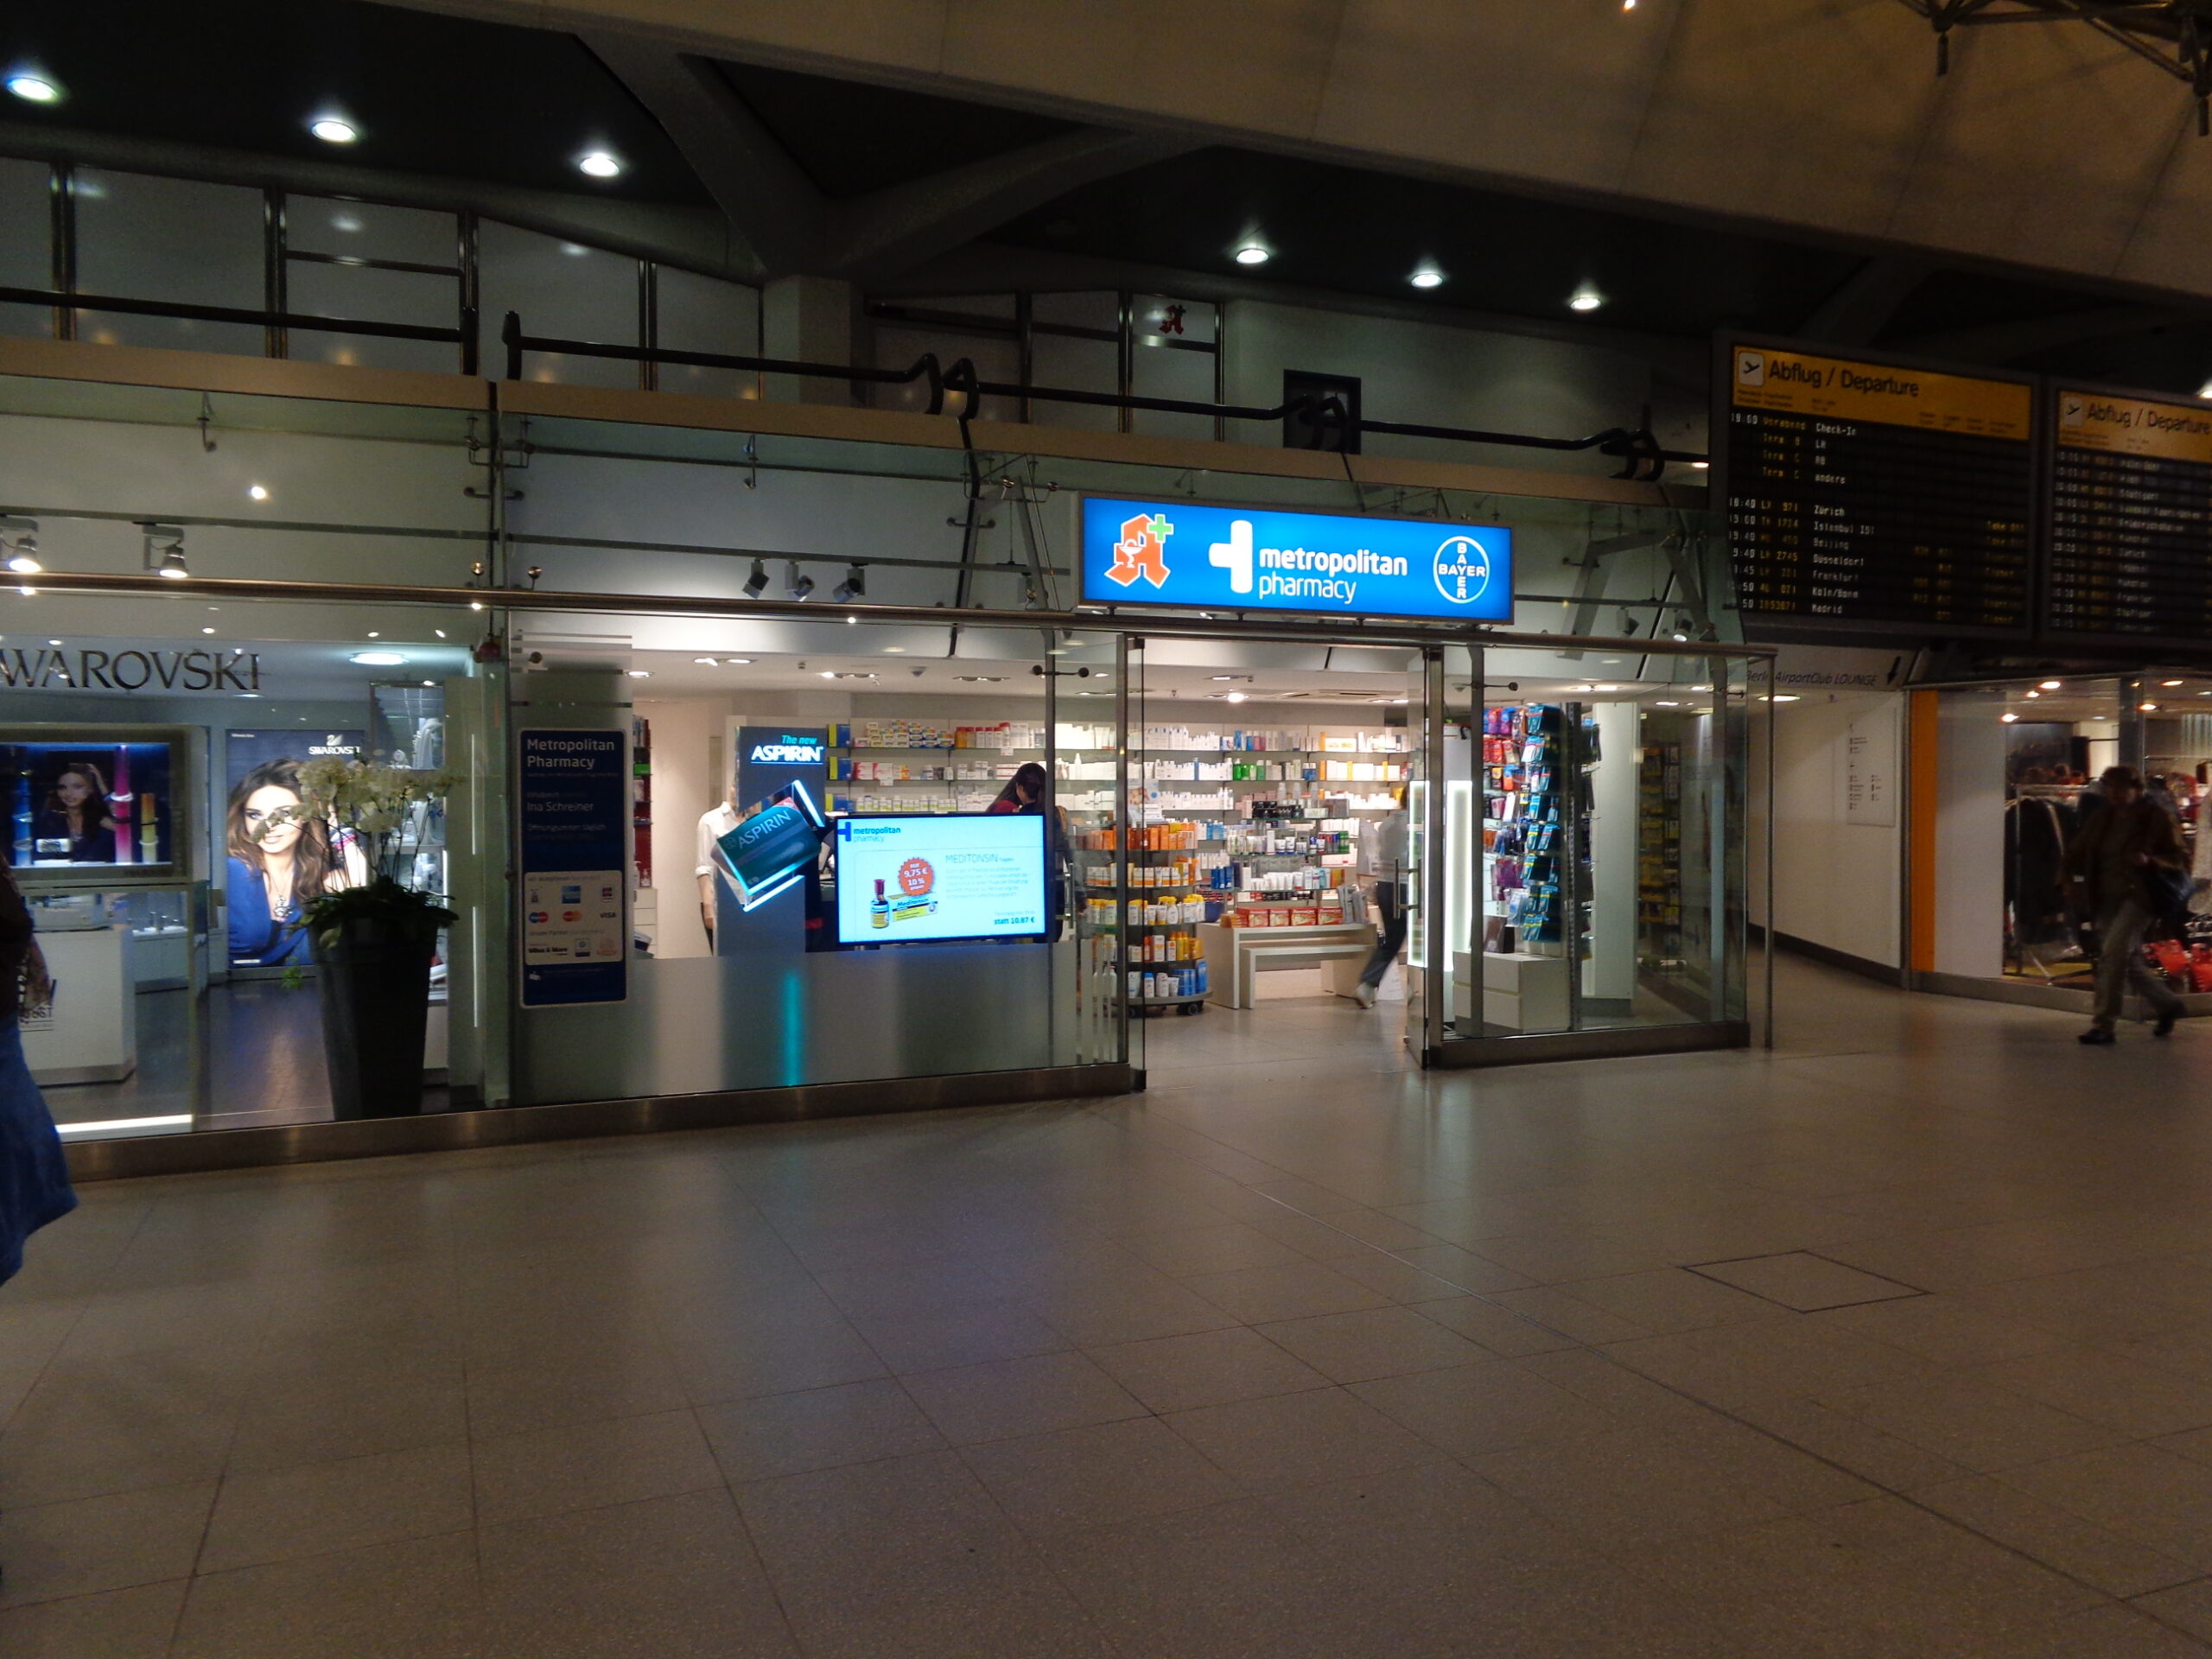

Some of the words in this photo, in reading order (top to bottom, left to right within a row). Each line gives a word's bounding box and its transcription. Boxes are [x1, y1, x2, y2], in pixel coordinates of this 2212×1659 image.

[1769, 360, 1821, 388] Abflug
[1826, 366, 1835, 386] /
[1841, 370, 1919, 397] Departure
[2088, 403, 2132, 428] Abflug
[2135, 408, 2143, 425] /
[2147, 410, 2211, 435] Departure
[1732, 547, 1755, 559] 9:40
[1259, 546, 1408, 576] metropolitan
[1438, 564, 1486, 577] BAYER
[1457, 542, 1467, 600] BAYER
[1259, 570, 1357, 604] pharmacy
[1775, 671, 1833, 684] AirportClub
[1834, 673, 1878, 686] LOUNGE
[526, 738, 615, 753] Metropolitan
[781, 734, 797, 744] The
[308, 746, 360, 755] SWAROVSI
[751, 745, 823, 762] ASPIRIN
[526, 755, 595, 770] Pharmacy
[527, 802, 543, 812] Ina
[546, 801, 594, 812] Schreiner
[738, 810, 791, 849] ASPIRIN
[945, 853, 999, 863] MEDITONSIN
